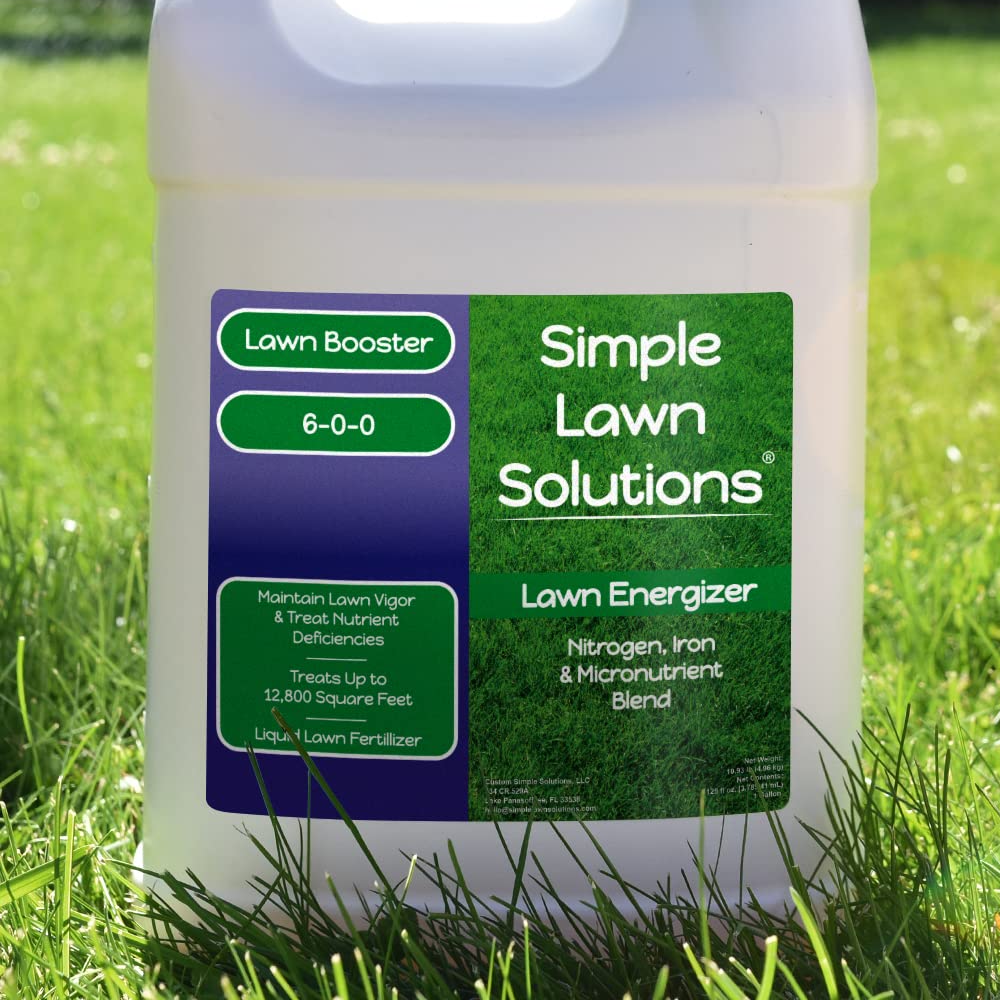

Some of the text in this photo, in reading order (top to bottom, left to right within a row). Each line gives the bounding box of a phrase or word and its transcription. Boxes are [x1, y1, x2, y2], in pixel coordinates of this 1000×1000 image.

[245, 328, 434, 353] Lawn Booster
[540, 320, 722, 382] Simple
[302, 412, 375, 436] 6-0-0
[556, 393, 706, 437] Lawn
[498, 459, 763, 508] Solutions
[258, 590, 416, 611] Maintain Lawn Vigor
[521, 580, 758, 612] Lawn Energizer
[274, 610, 400, 627] & Treat Nutrient
[292, 630, 385, 646] Deficiencies
[567, 635, 716, 661] Nitrogen, Iron
[289, 669, 387, 689] Treats Up to
[559, 661, 724, 684] & Micronutrient
[263, 688, 413, 709] 12,800 Square Feet
[612, 689, 672, 710] Blend
[304, 729, 346, 745] Lawn
[350, 731, 423, 747] Fertillizer
[513, 778, 538, 786] Simple
